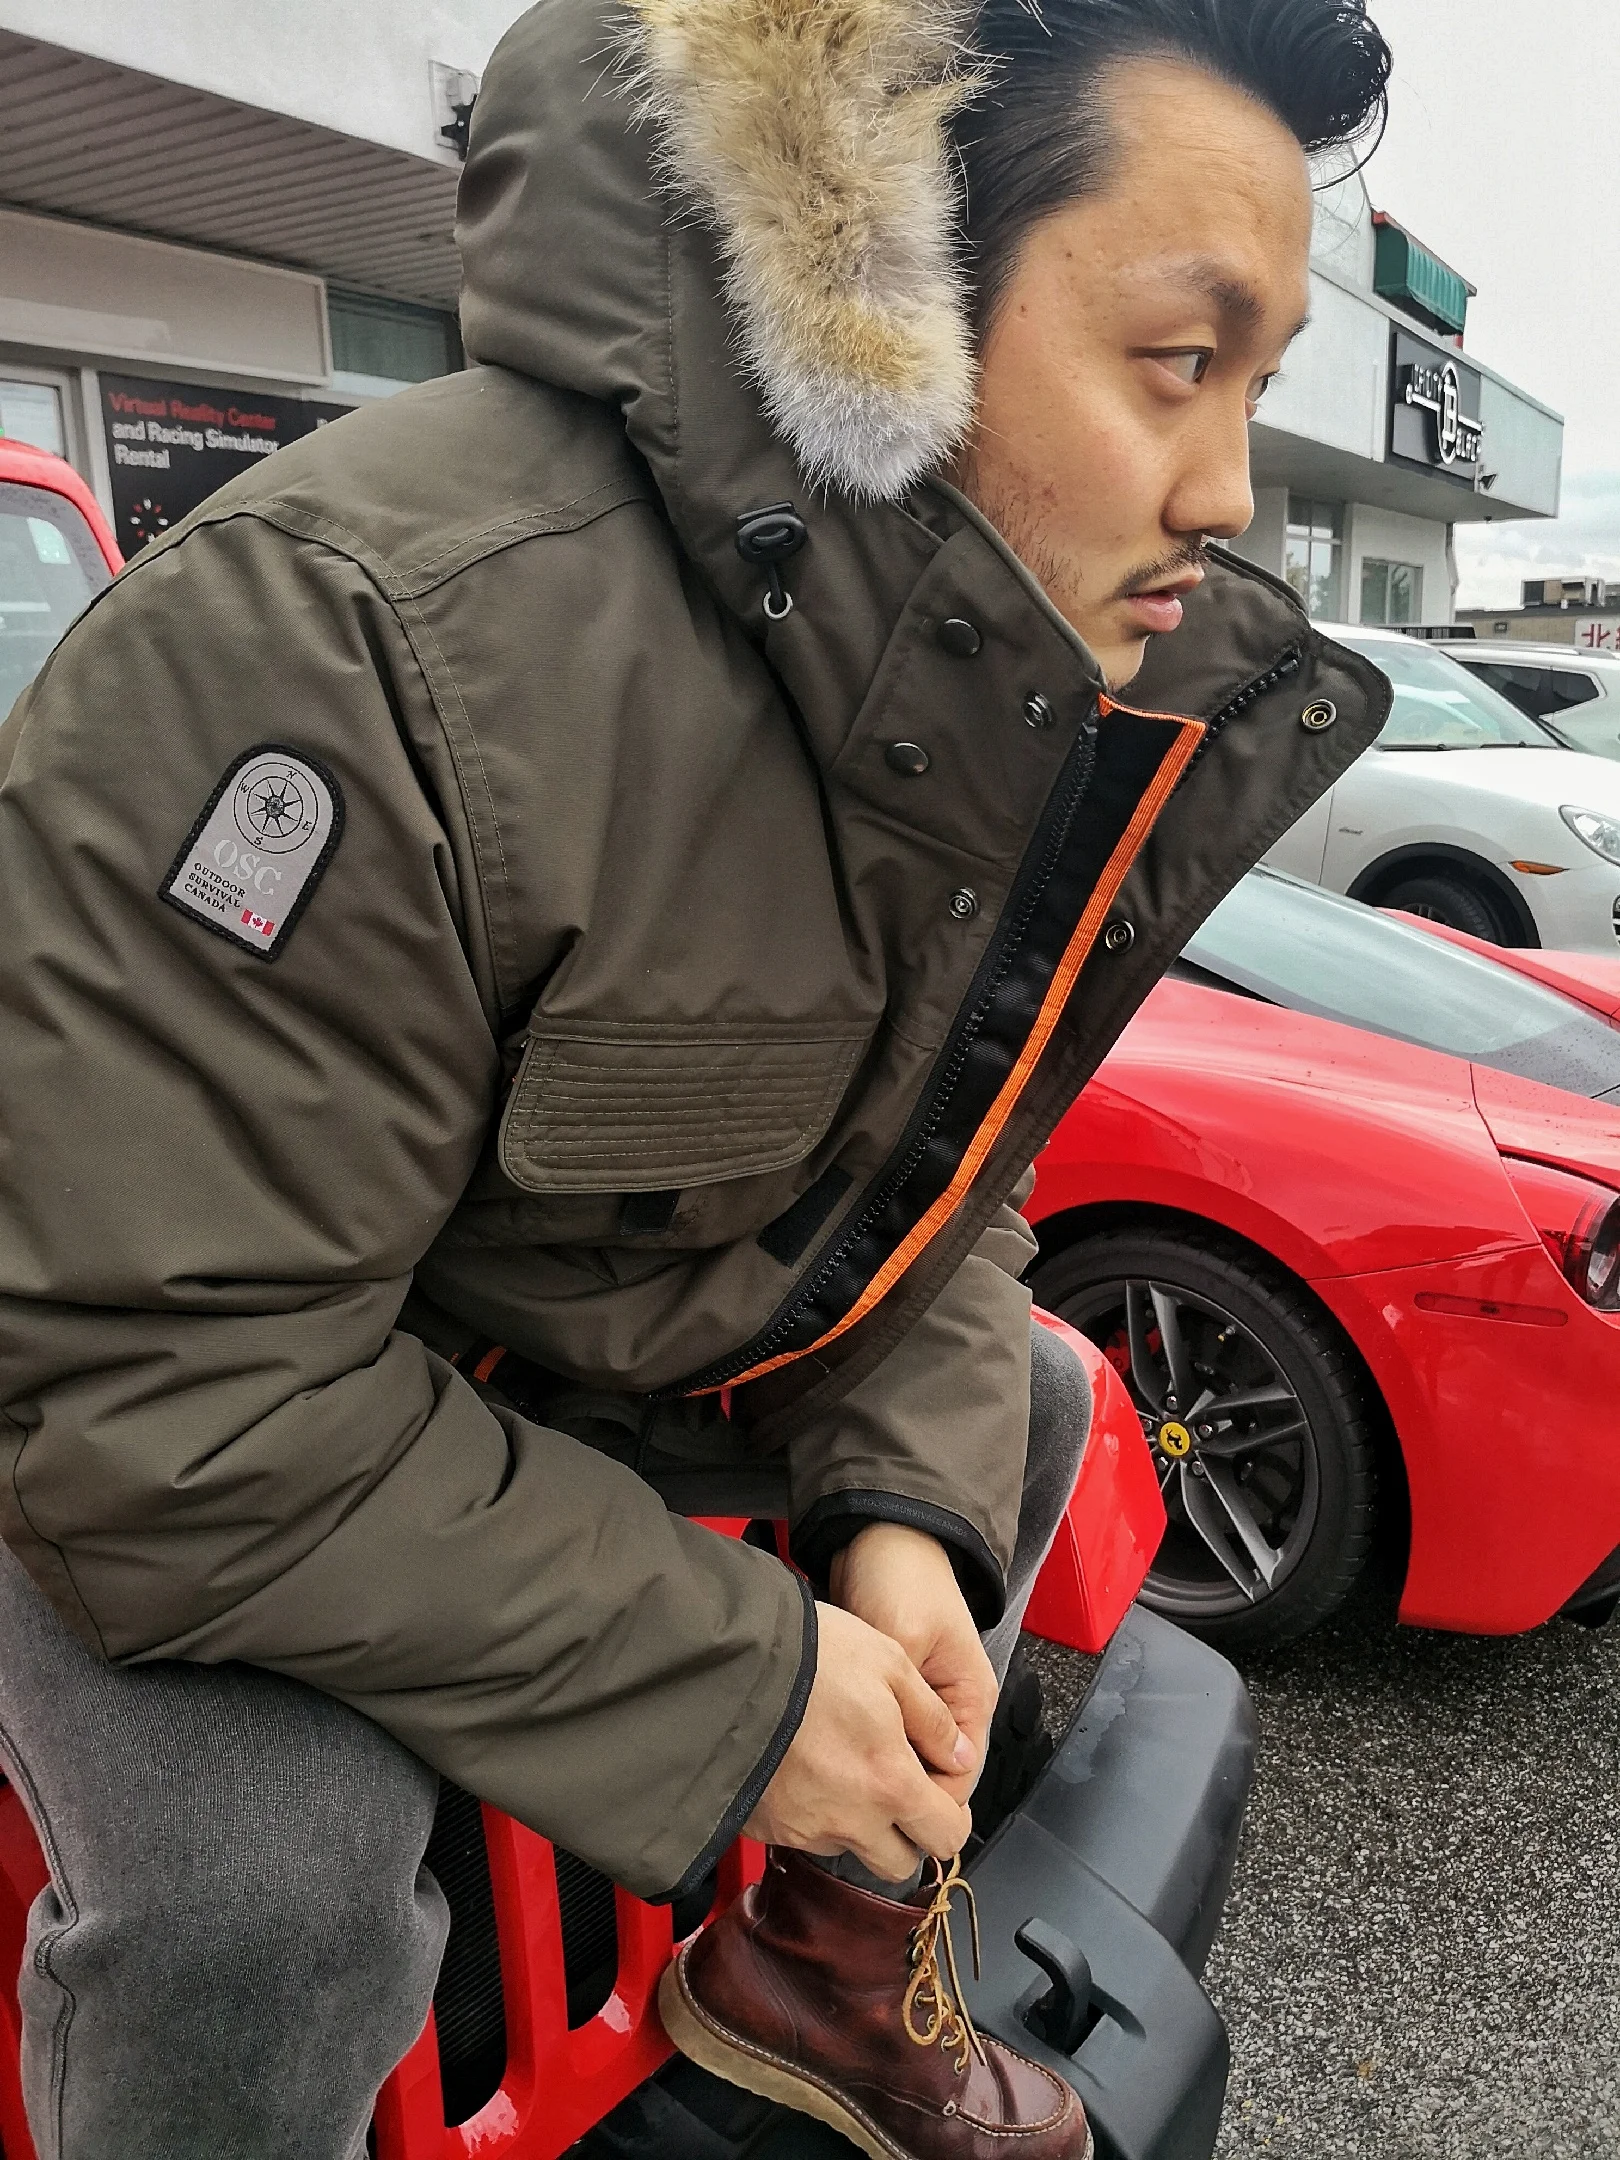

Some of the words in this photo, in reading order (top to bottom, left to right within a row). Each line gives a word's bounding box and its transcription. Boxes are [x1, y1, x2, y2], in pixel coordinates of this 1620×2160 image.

[109, 392, 166, 416] Virtual
[170, 400, 225, 428] Reality
[228, 408, 276, 430] Center
[112, 421, 146, 441] and
[147, 421, 204, 450] Racing
[205, 428, 279, 453] Simulator
[114, 443, 170, 469] Rental
[1581, 623, 1620, 649] 北
[194, 862, 246, 898] OUTDOOR
[213, 839, 282, 896] OSC
[184, 882, 226, 913] CANADA
[188, 872, 241, 908] SURVIVAL
